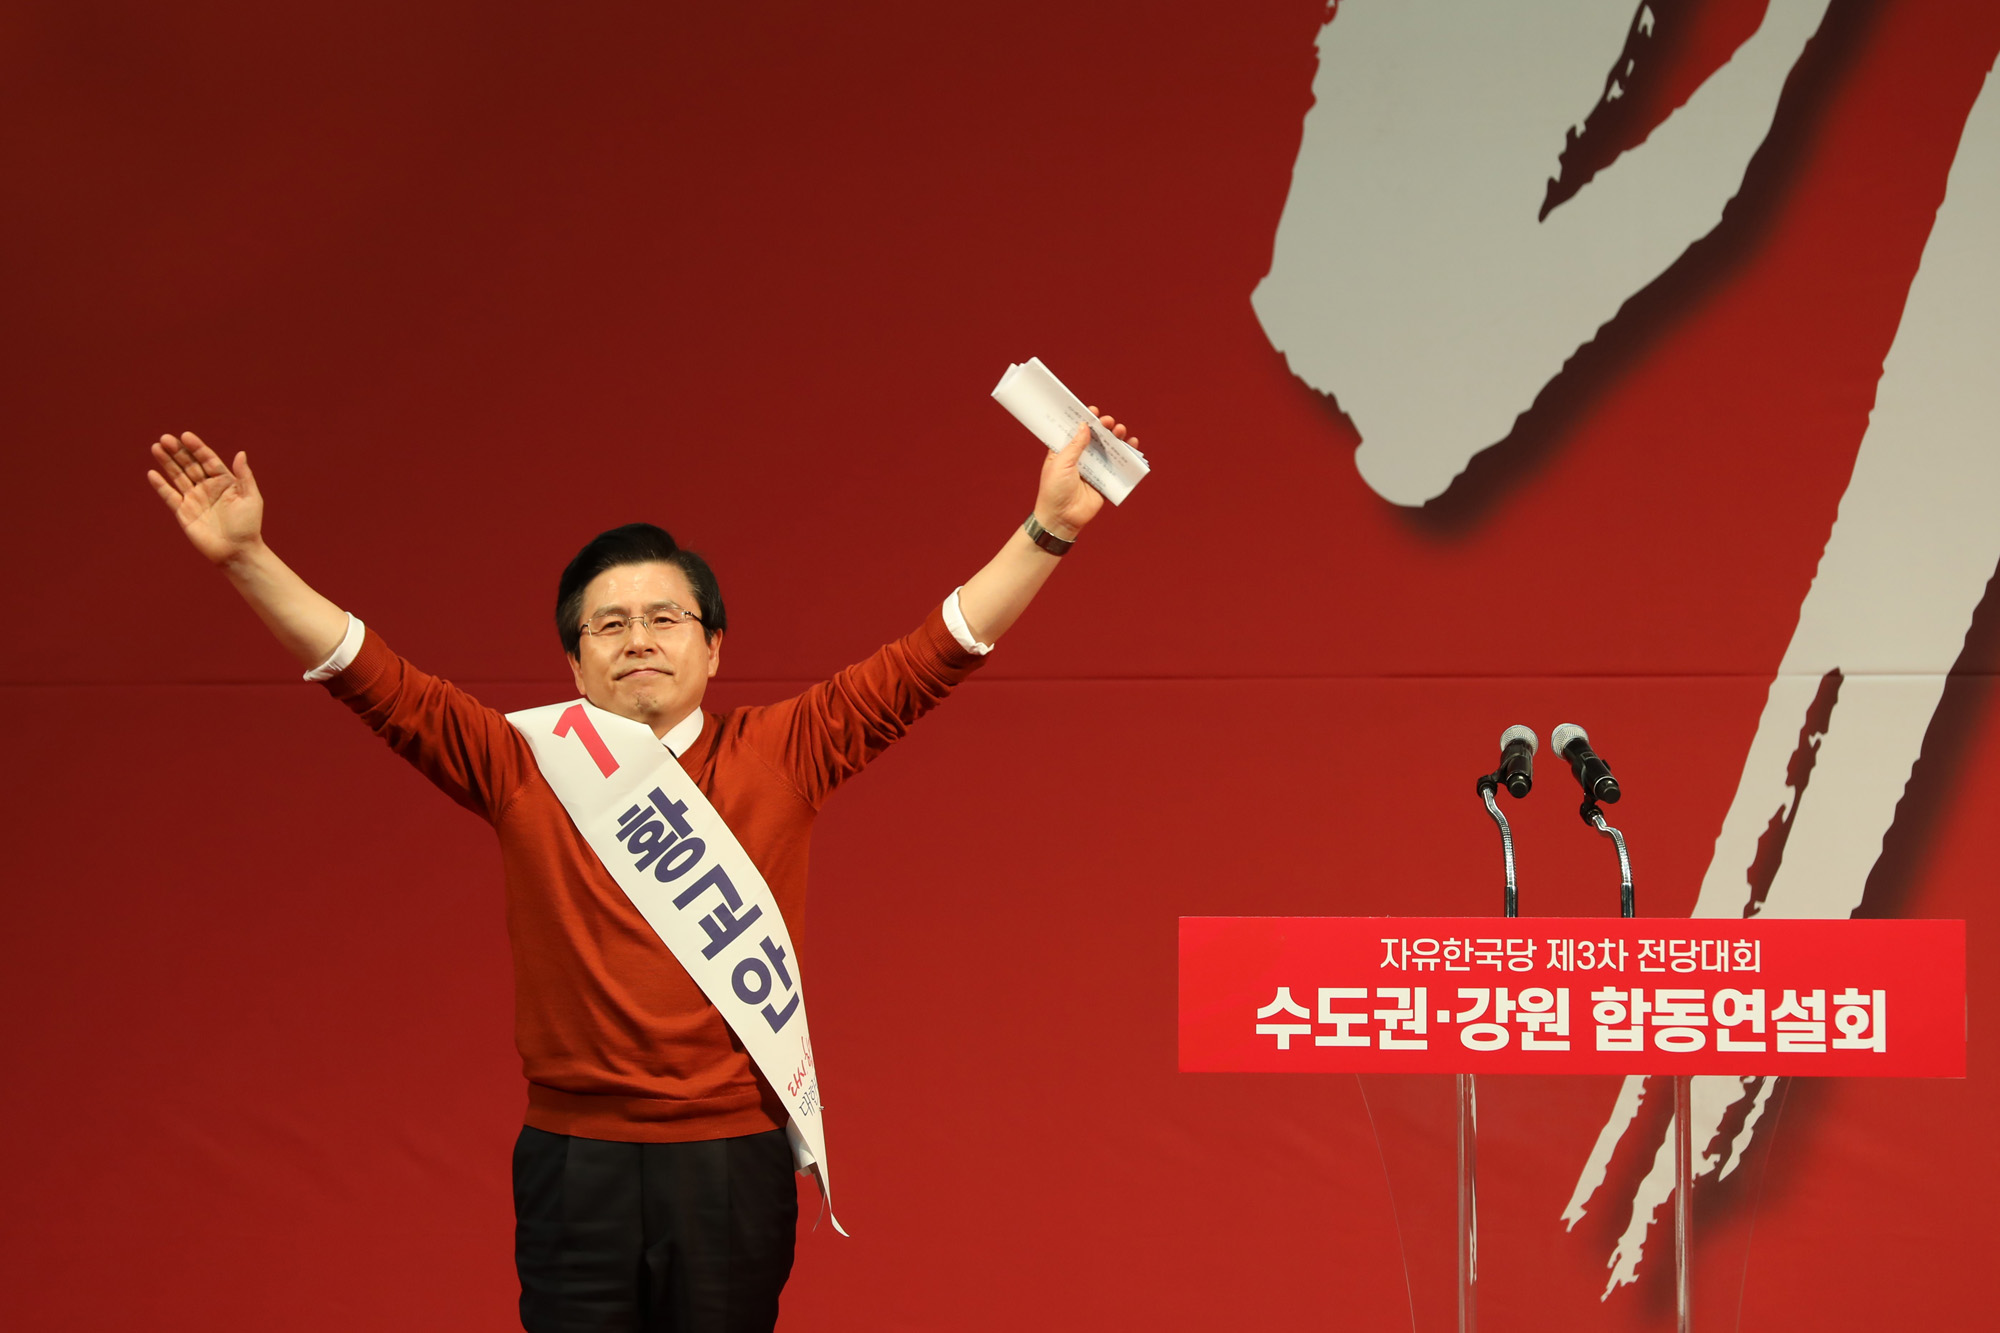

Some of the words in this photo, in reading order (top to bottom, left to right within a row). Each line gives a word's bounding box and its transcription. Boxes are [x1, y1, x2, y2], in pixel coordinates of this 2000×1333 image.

[552, 703, 620, 778] 1
[616, 787, 800, 1034] 황교안
[1380, 937, 1538, 972] 자유한국당
[1546, 937, 1629, 972] 제3차
[1637, 938, 1762, 973] 전당대회
[1255, 986, 1571, 1052] 수도권·강원
[1590, 986, 1887, 1053] 합동연설회
